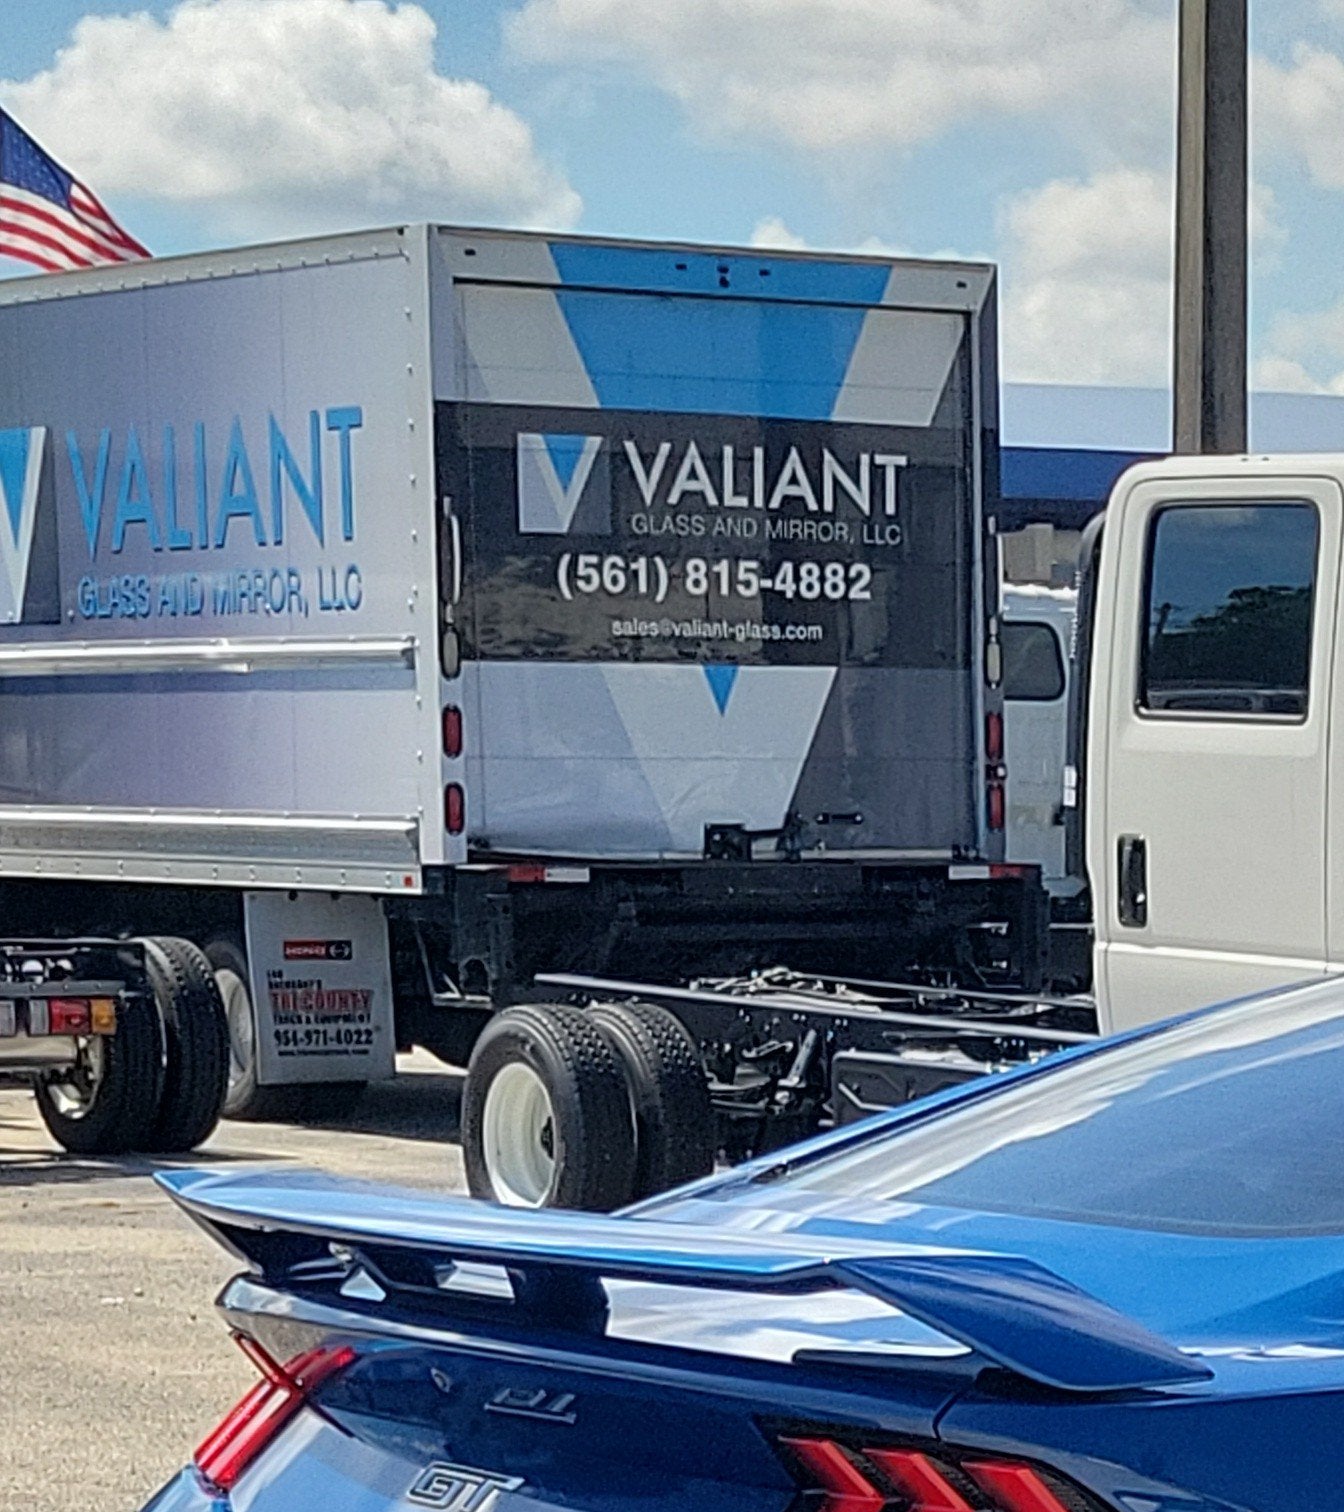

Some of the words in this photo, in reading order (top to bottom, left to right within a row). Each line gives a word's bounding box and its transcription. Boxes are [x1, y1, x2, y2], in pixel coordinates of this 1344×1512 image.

[65, 406, 363, 562] VALIANT
[624, 441, 908, 516] VALIANT
[631, 513, 705, 536] GLASS
[713, 517, 757, 538] AND
[765, 519, 855, 545] MIRROR,
[863, 524, 902, 546] LLC
[77, 574, 151, 619] GLASS
[158, 570, 205, 618] AND
[211, 566, 309, 619] MIRROR,
[317, 563, 363, 612] LLC
[557, 554, 669, 603] (561)
[685, 557, 872, 600] 815-4882
[611, 617, 823, 642] sales@valiant-glass.com
